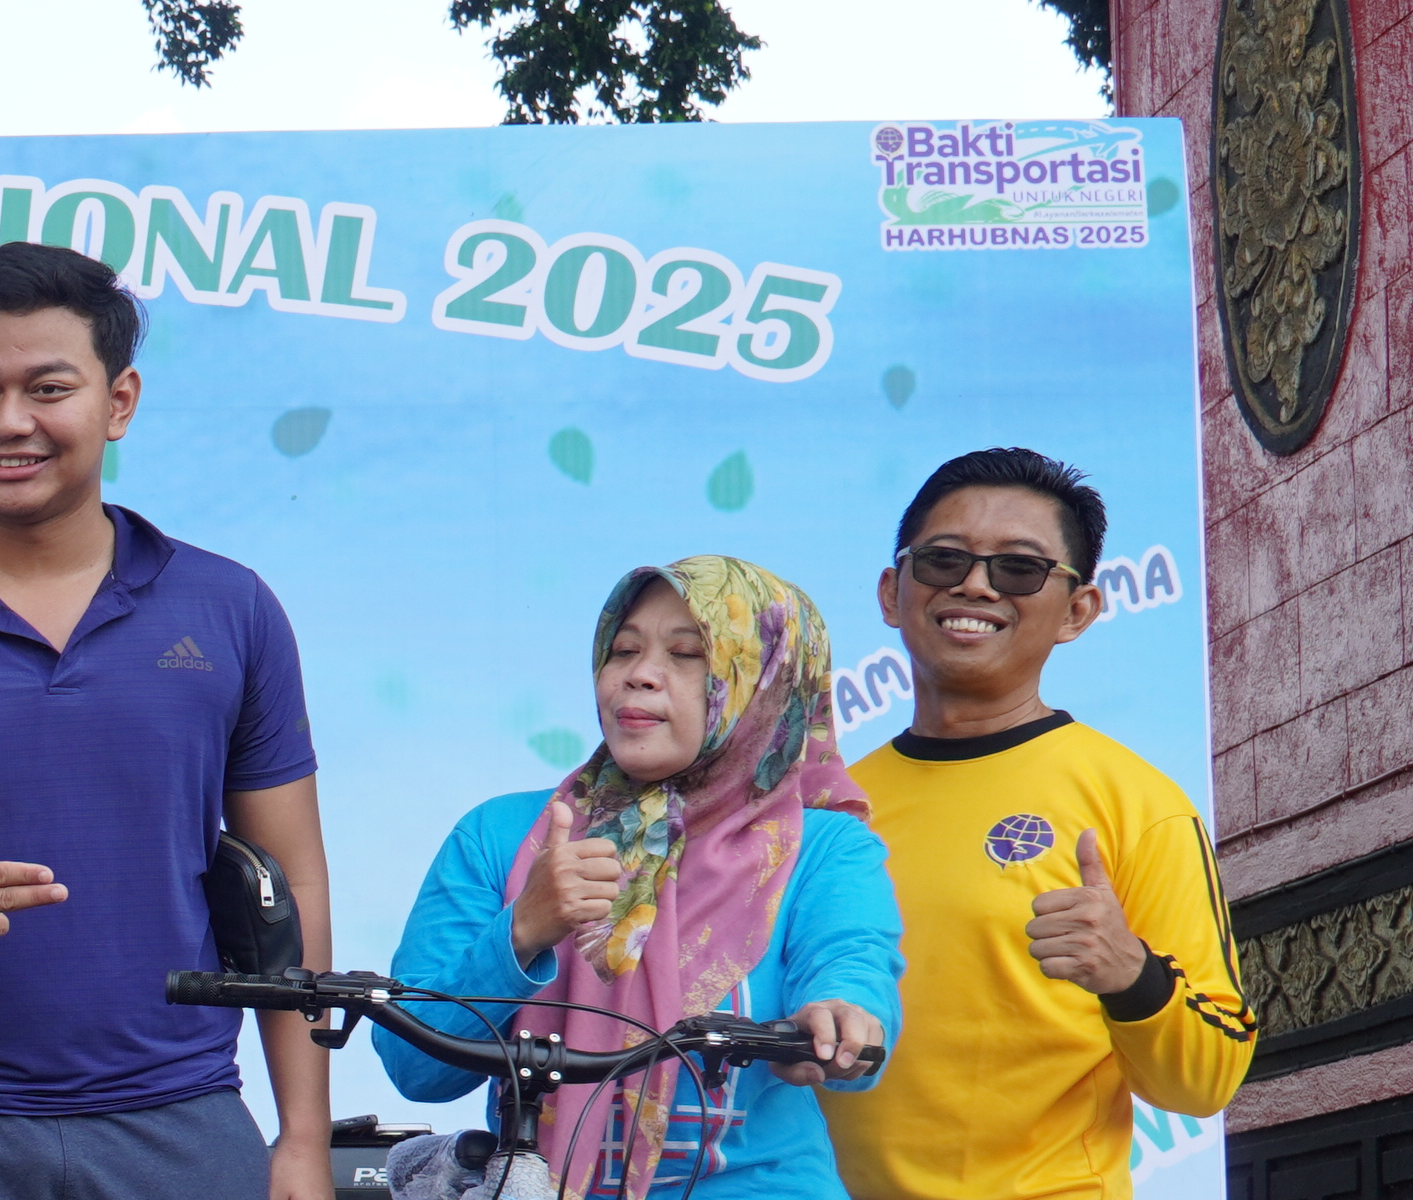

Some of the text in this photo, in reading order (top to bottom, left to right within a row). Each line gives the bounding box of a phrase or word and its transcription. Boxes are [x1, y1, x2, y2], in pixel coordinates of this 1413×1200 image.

[907, 122, 1014, 158] Bakti
[876, 148, 1142, 194] Transportasi
[1013, 189, 1144, 203] UNTUK NEGERI
[886, 226, 1145, 246] HARHUBNAS 2025
[445, 231, 827, 371] 2025
[1097, 552, 1174, 613] MA
[157, 655, 214, 672] adidas
[836, 655, 911, 724] AM
